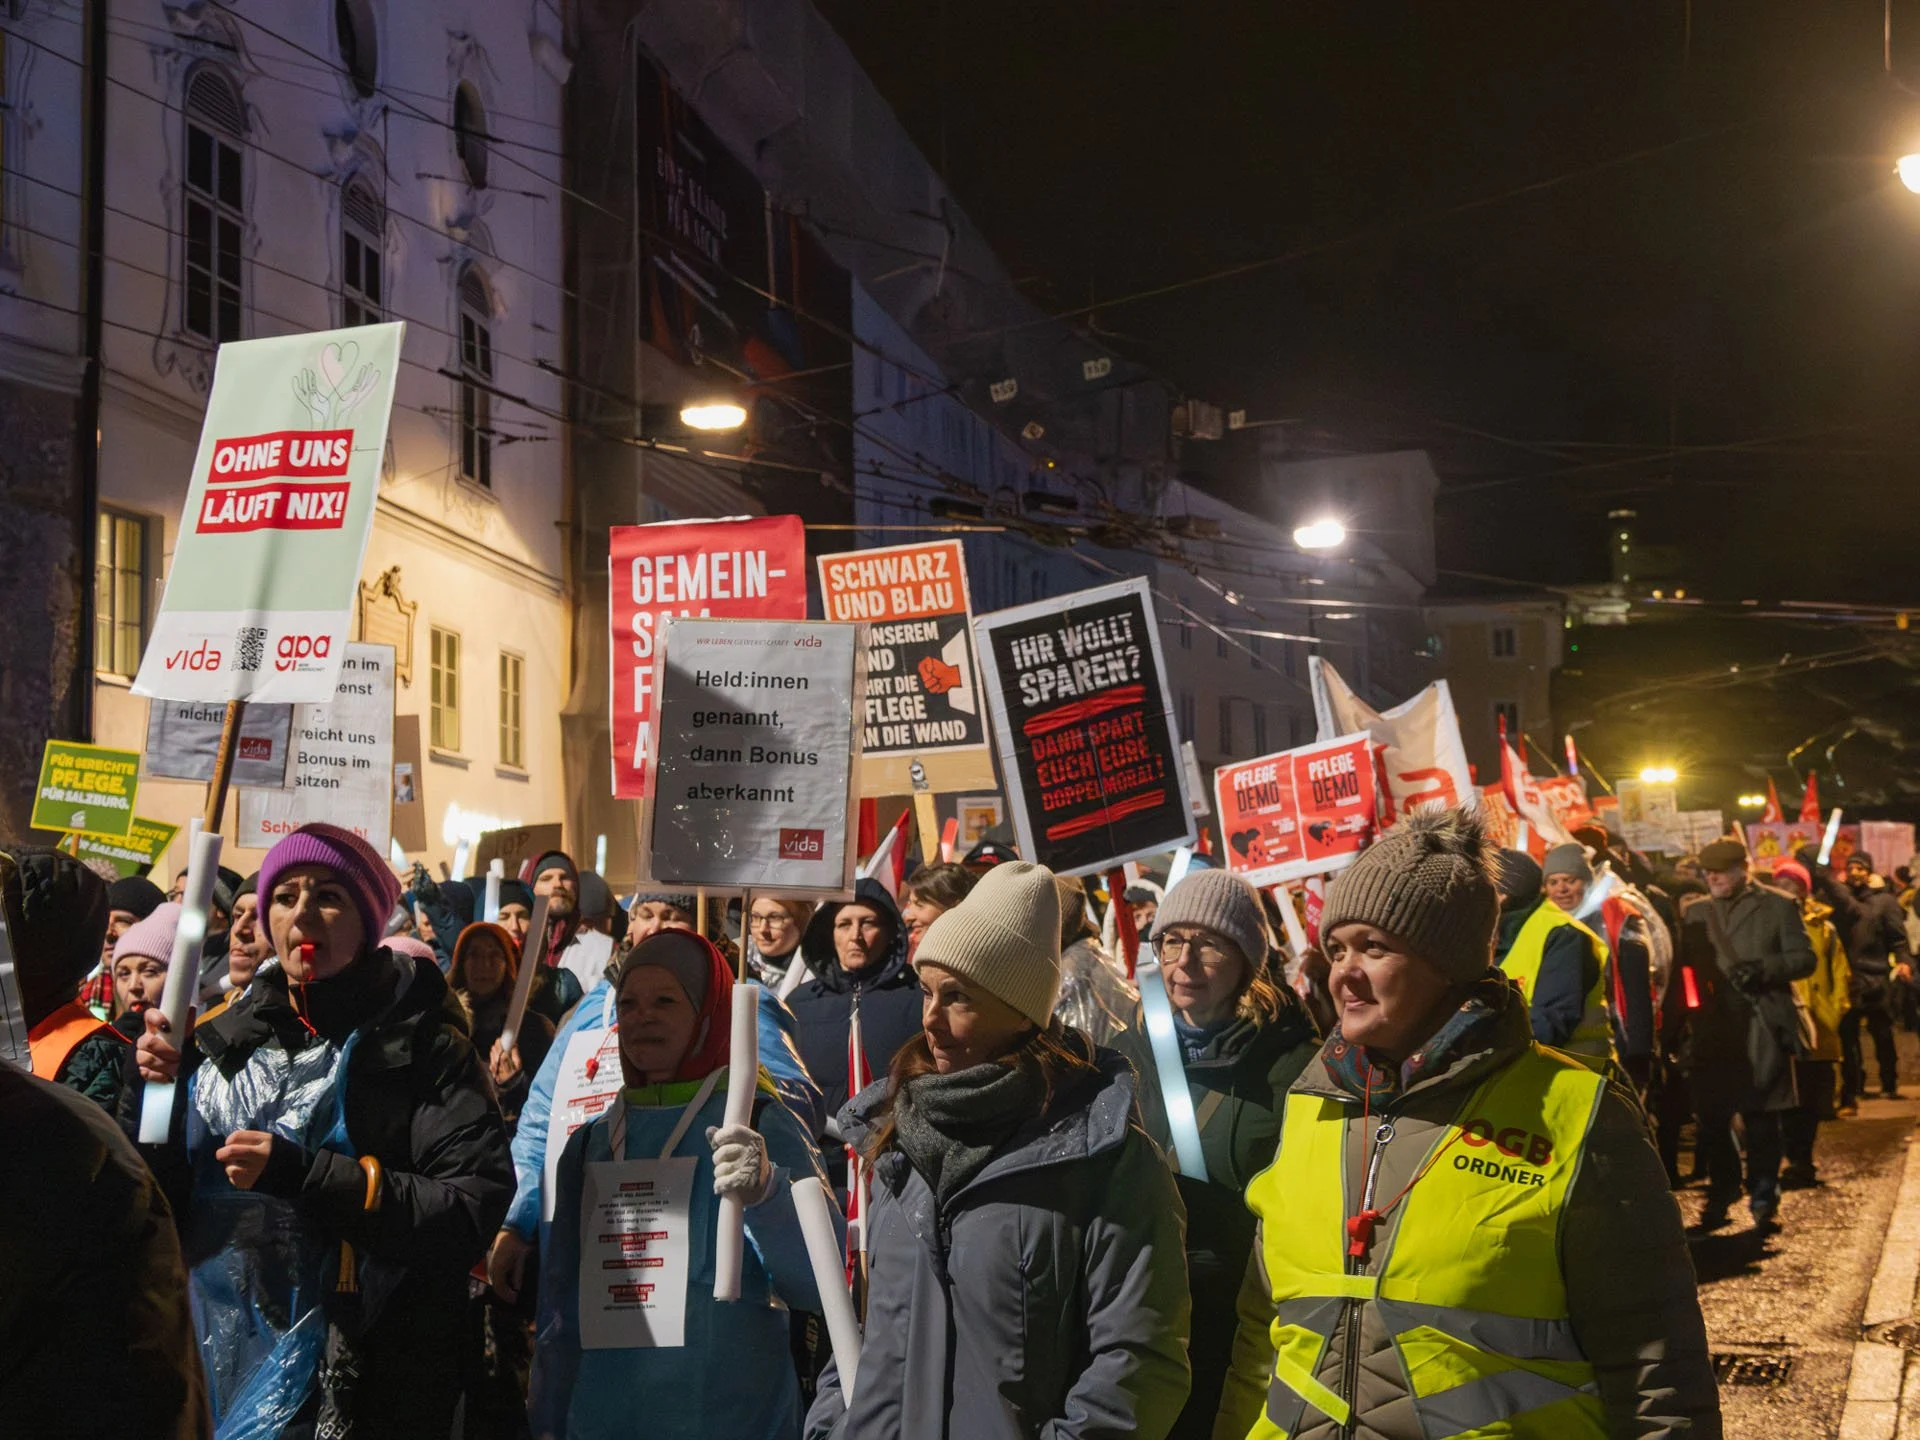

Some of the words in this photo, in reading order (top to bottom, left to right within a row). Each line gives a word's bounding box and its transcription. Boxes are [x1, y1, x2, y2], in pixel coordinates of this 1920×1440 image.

[214, 440, 284, 474] OHNE
[289, 438, 348, 467] UNS
[202, 490, 282, 524] LÄUFT
[286, 491, 345, 519] NIX!
[632, 551, 786, 604] GEMEIN-
[829, 551, 951, 591] SCHWARZ
[833, 590, 886, 621] UND
[890, 581, 954, 615] BLAU
[793, 635, 823, 648] vida
[869, 621, 939, 647] NSEREM
[1011, 633, 1057, 670] IHR
[1058, 612, 1134, 658] WOLLT
[165, 639, 222, 671] vida
[362, 658, 380, 671] im
[868, 648, 895, 672] ND
[695, 670, 809, 690] Held:innen
[894, 675, 919, 694] DIE
[1019, 645, 1141, 707] SPAREN?
[692, 710, 784, 729] genannt,
[865, 695, 928, 723] FLEGE
[348, 732, 376, 744] uns
[882, 725, 911, 746] DIE
[913, 720, 967, 744] WAND
[1031, 727, 1085, 761] DANN
[1087, 711, 1144, 745] SPART
[50, 753, 73, 767] FÜR
[75, 757, 136, 775] GERECHTE
[298, 752, 346, 767] Bonus
[352, 755, 371, 768] im
[690, 745, 742, 762] dann
[750, 746, 818, 765] Bonus
[1036, 751, 1096, 788] EUCH
[1101, 736, 1148, 771] EURE
[1308, 752, 1356, 781] PFLEGE
[50, 768, 127, 795] PFLEGE.
[1233, 763, 1278, 791] PFLEGE
[1312, 772, 1359, 804] DEMO
[40, 786, 64, 801] FÜR
[65, 791, 130, 810] SALZBURG.
[687, 783, 795, 803] aberkannt
[1236, 781, 1279, 812] DEMO
[784, 833, 819, 852] vida
[1453, 1154, 1545, 1187] ORDNER
